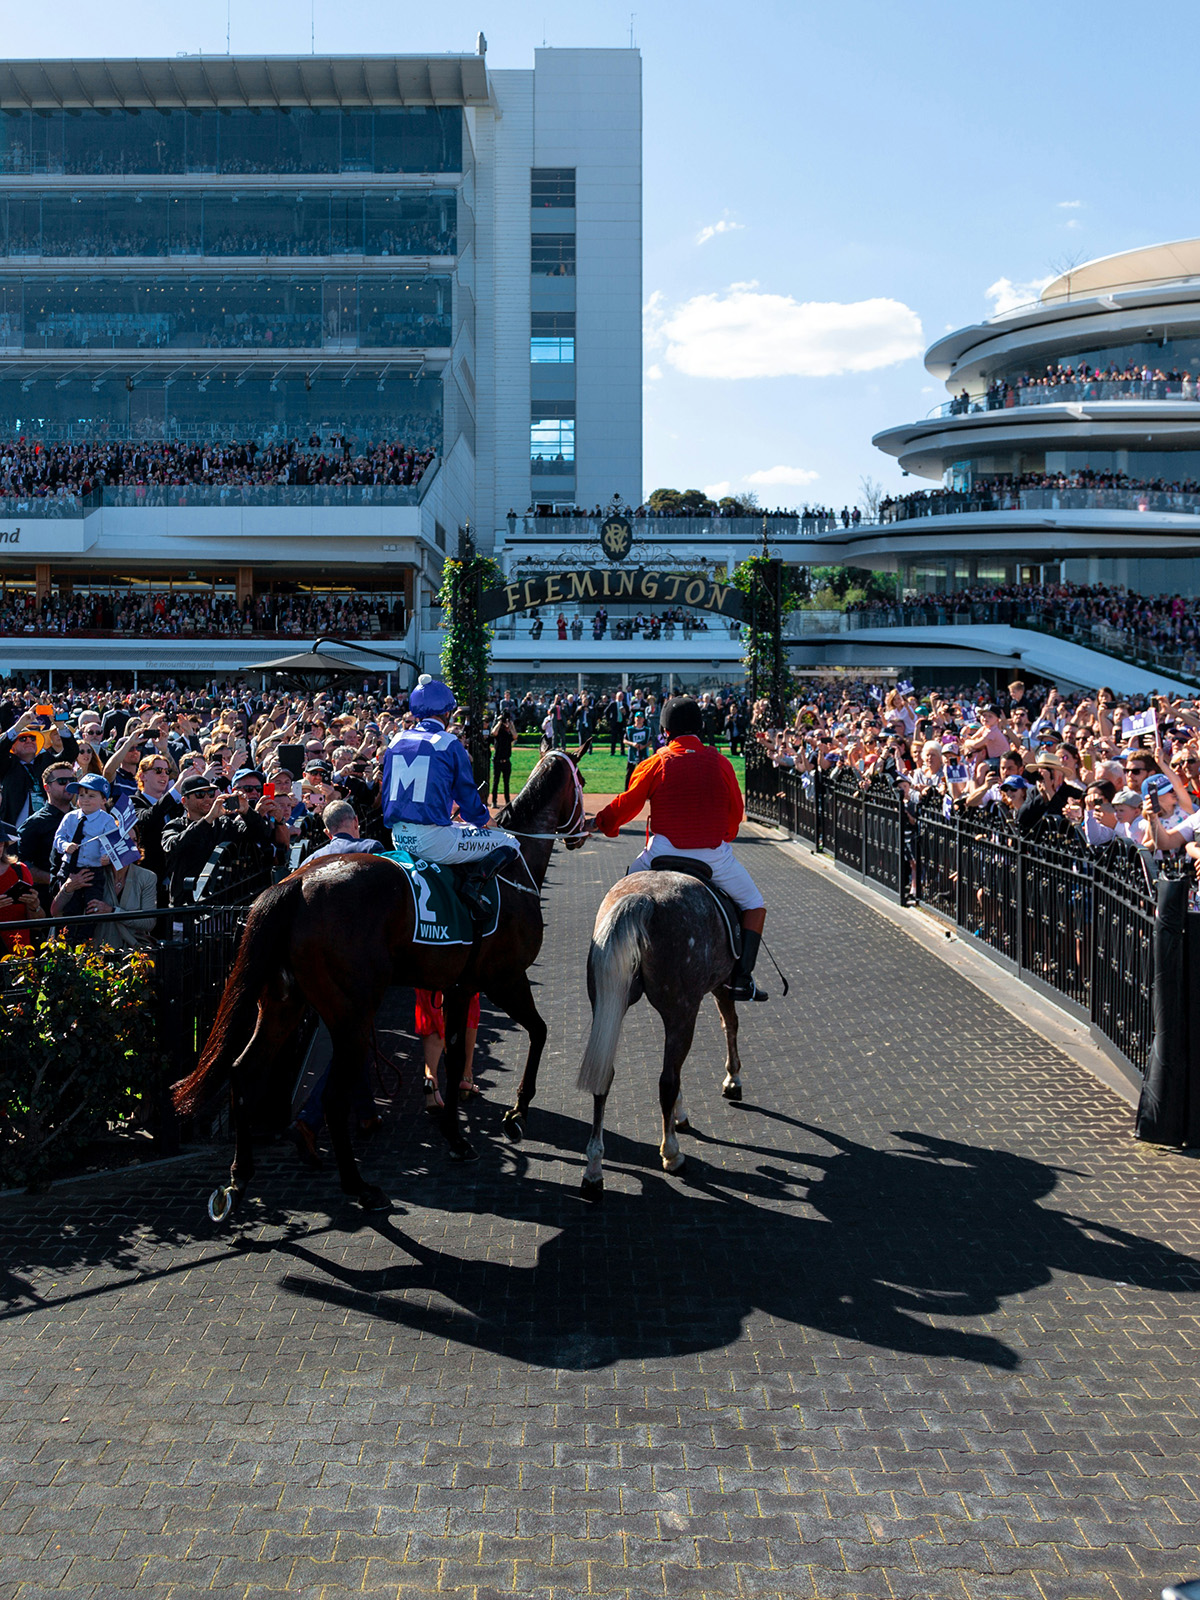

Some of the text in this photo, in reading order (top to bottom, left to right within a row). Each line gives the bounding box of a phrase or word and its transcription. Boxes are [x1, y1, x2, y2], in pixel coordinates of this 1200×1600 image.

[502, 569, 732, 612] FLEMINGTON
[197, 660, 215, 670] yard
[1132, 718, 1145, 730] M
[390, 754, 431, 803] M
[113, 839, 130, 856] M
[420, 923, 450, 940] WINX
